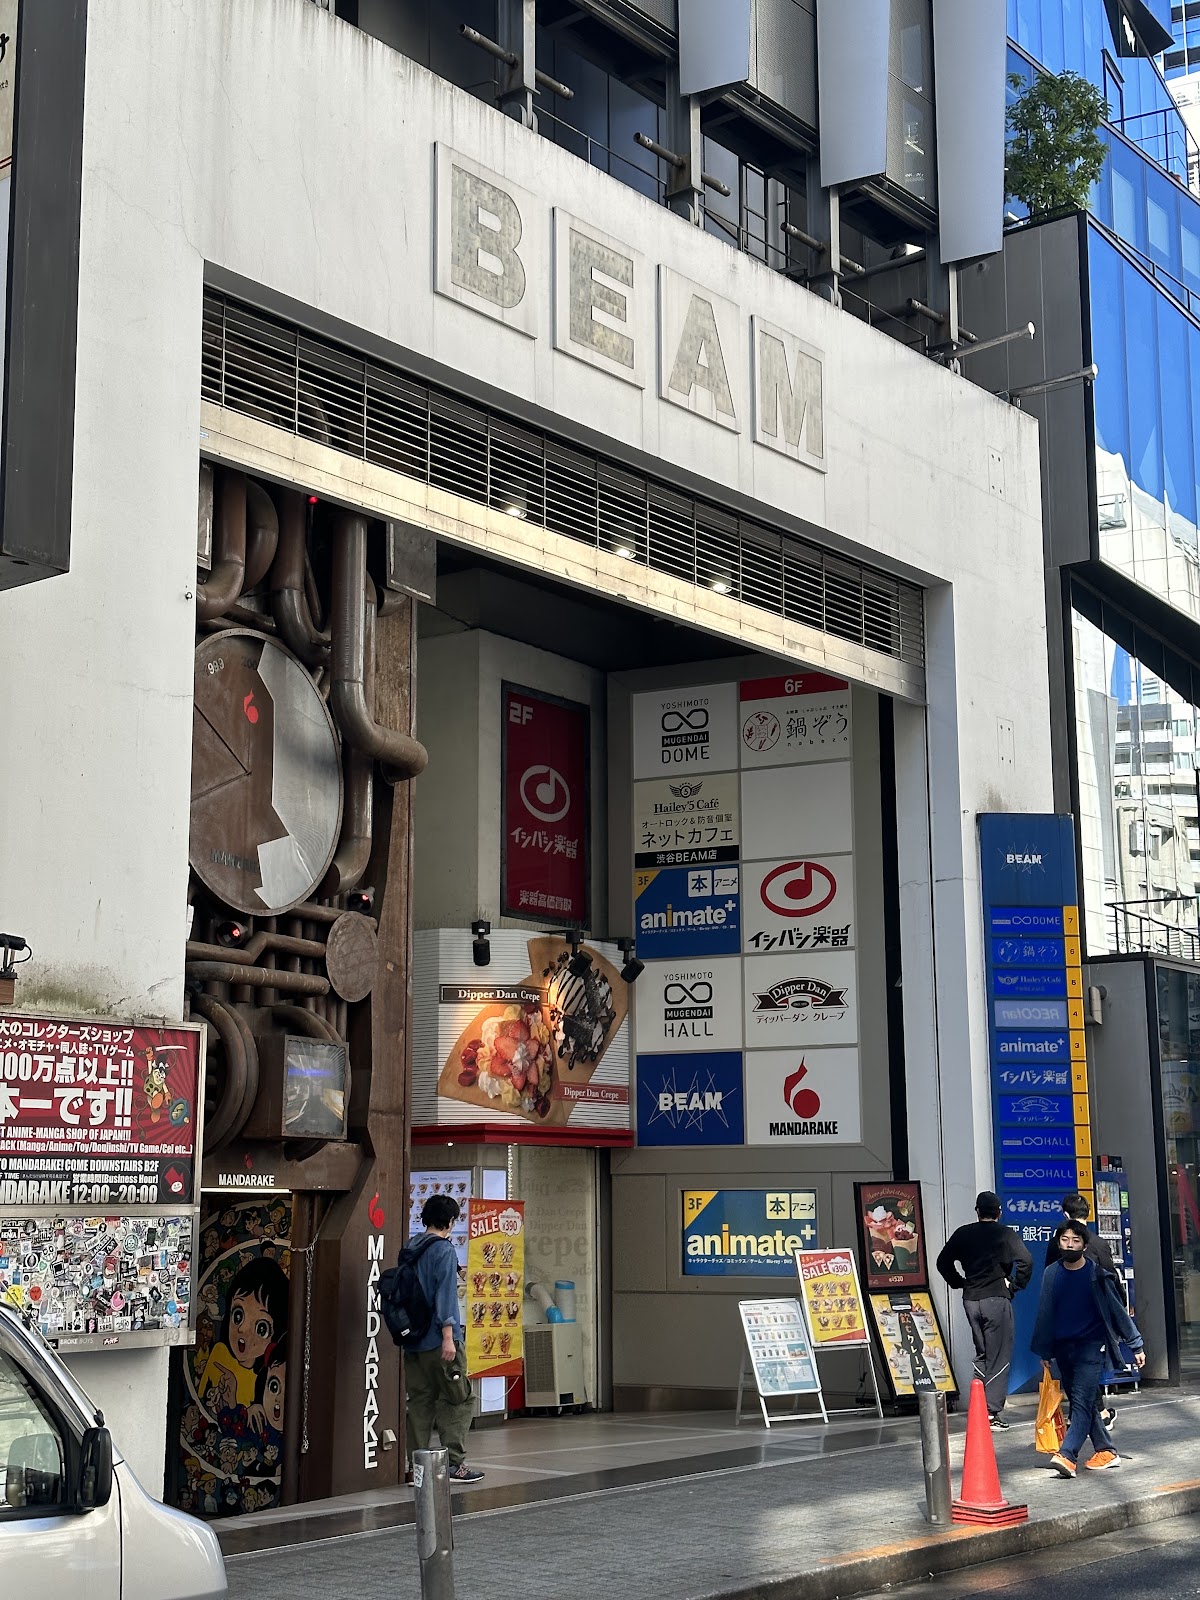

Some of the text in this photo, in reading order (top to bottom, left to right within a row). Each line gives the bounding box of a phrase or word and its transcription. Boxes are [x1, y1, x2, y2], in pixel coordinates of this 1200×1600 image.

[450, 164, 824, 460] BEAM
[784, 678, 803, 694] 6F
[661, 698, 709, 710] YOSHIMOTO
[509, 701, 533, 725] 2F
[785, 712, 848, 739] 鍋ぞう
[663, 733, 708, 746] MUGENDAI
[661, 745, 710, 764] DOME
[696, 798, 719, 810] Café
[510, 826, 579, 859] イシバシ楽器
[641, 826, 733, 849] ネットカフェ
[656, 849, 717, 864] 渋谷BEAM店
[1006, 853, 1042, 865] BEAM
[637, 875, 649, 886] 3F
[691, 874, 708, 893] 本
[714, 876, 738, 889] アニメ
[1032, 916, 1060, 925] DOME
[748, 924, 852, 950] イシバシ楽器
[1022, 945, 1058, 957] 鍋ぞう
[663, 971, 713, 981] YOSHIMOTO
[458, 989, 540, 1002] Dipper Dan Crepe
[772, 981, 827, 999] Dipper Dan
[666, 1008, 712, 1019] MUGENDAI
[756, 1011, 845, 1024] ディッパーダン クレープ
[664, 1021, 713, 1038] HALL
[0, 1038, 135, 1057] メ・オモチャ・同人誌・TVゲーム
[1000, 1070, 1069, 1085] イシバシ楽器
[564, 1086, 619, 1099] Dipper Dan Crepe
[658, 1091, 722, 1111] BEAM
[7, 1126, 65, 1139] ANIME-MANGA
[66, 1128, 88, 1140] SHOP
[89, 1129, 99, 1140] OF
[769, 1121, 839, 1136] MANDARAKE
[1044, 1136, 1071, 1146] HALL
[9, 1158, 64, 1171] MANDARAKE!
[65, 1158, 89, 1171] COME
[89, 1159, 143, 1172] DOWNSTAIRS
[144, 1160, 159, 1172] B2F
[5, 1172, 20, 1180] TIME
[218, 1173, 275, 1187] MANDARAKE
[1046, 1169, 1073, 1178] HALL
[688, 1197, 703, 1210] 3F
[769, 1197, 786, 1215] 本
[791, 1201, 815, 1212] アニメ
[471, 1216, 499, 1237] SALE
[803, 1263, 830, 1279] SALE
[363, 1234, 384, 1470] MANDARAKE
